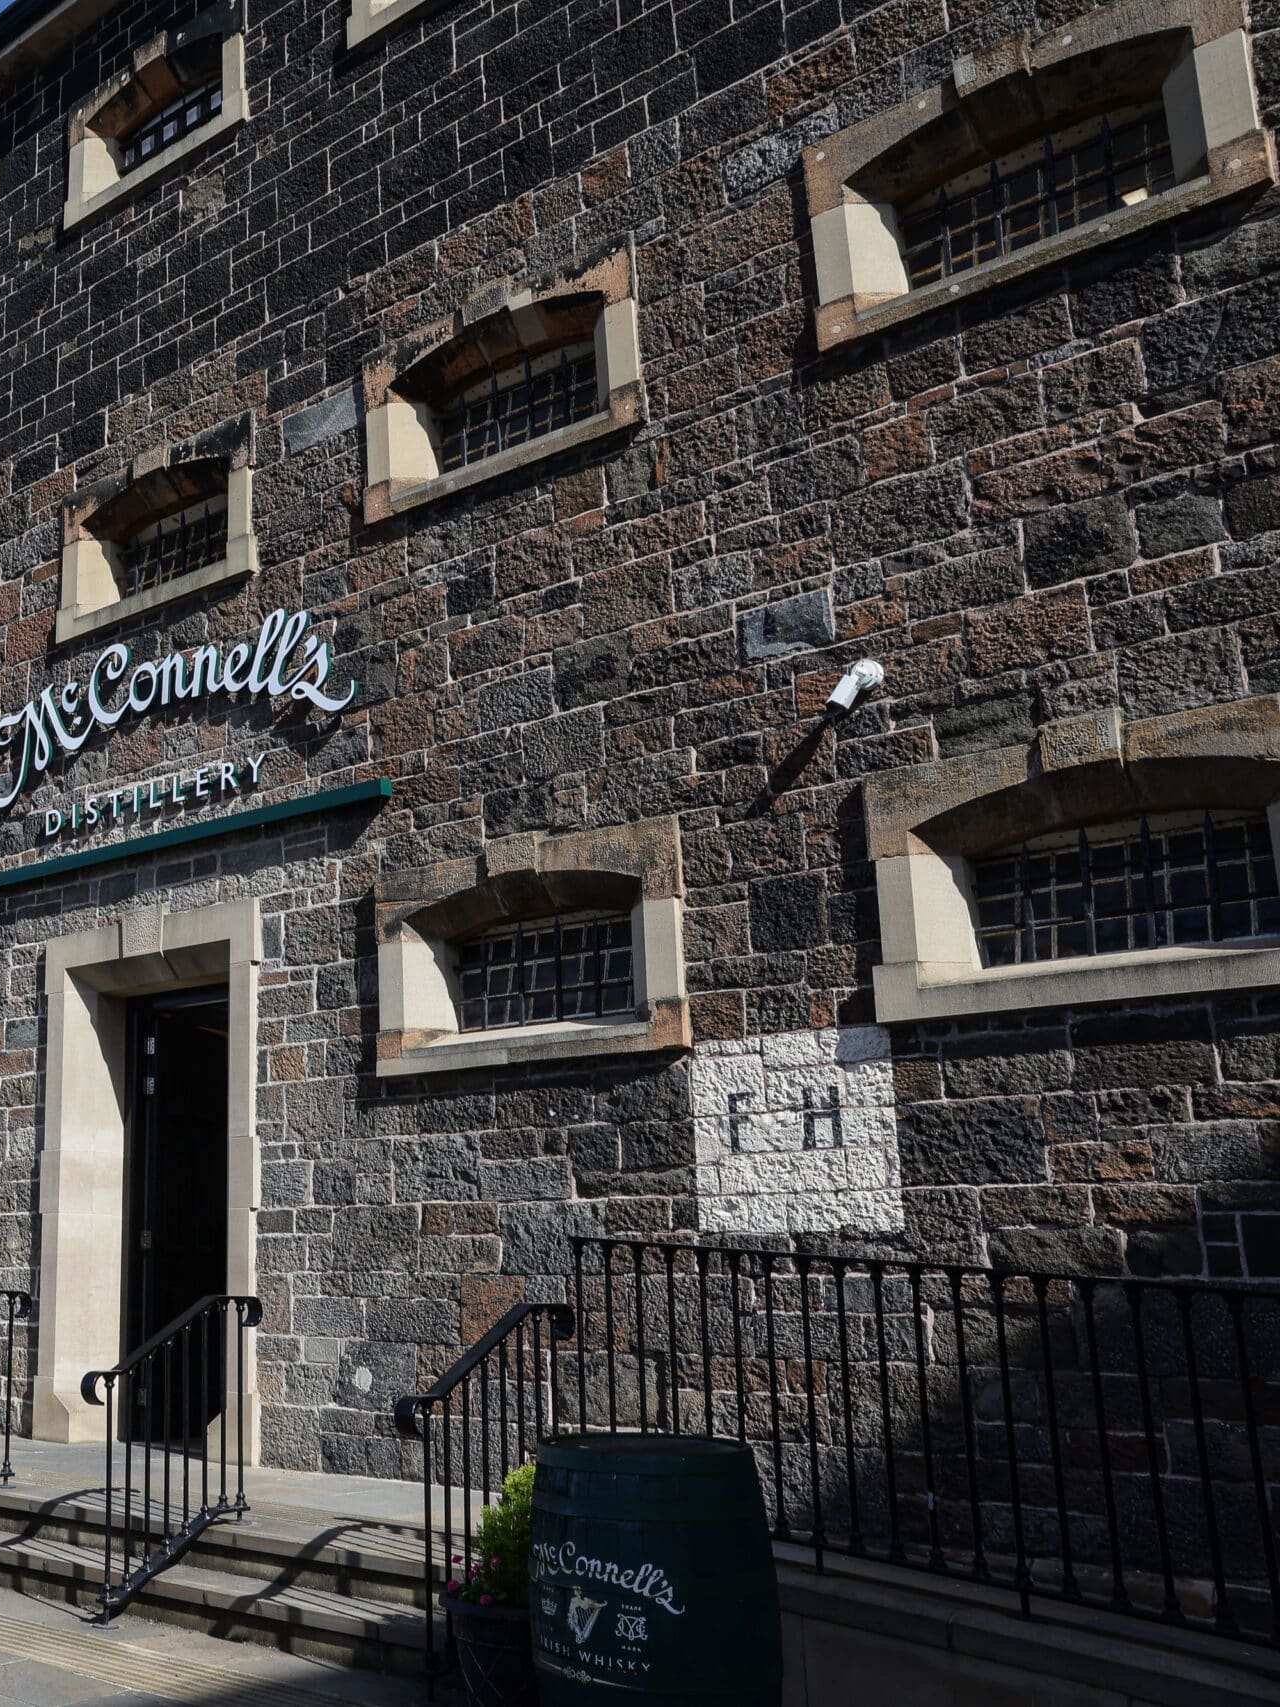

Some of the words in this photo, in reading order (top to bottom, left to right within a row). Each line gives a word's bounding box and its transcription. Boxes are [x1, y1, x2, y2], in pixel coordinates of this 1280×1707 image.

[45, 754, 267, 837] DISTILLERY
[531, 1541, 685, 1616] McConnell's
[540, 1634, 570, 1657] IRISH
[578, 1650, 651, 1672] WHISKY
